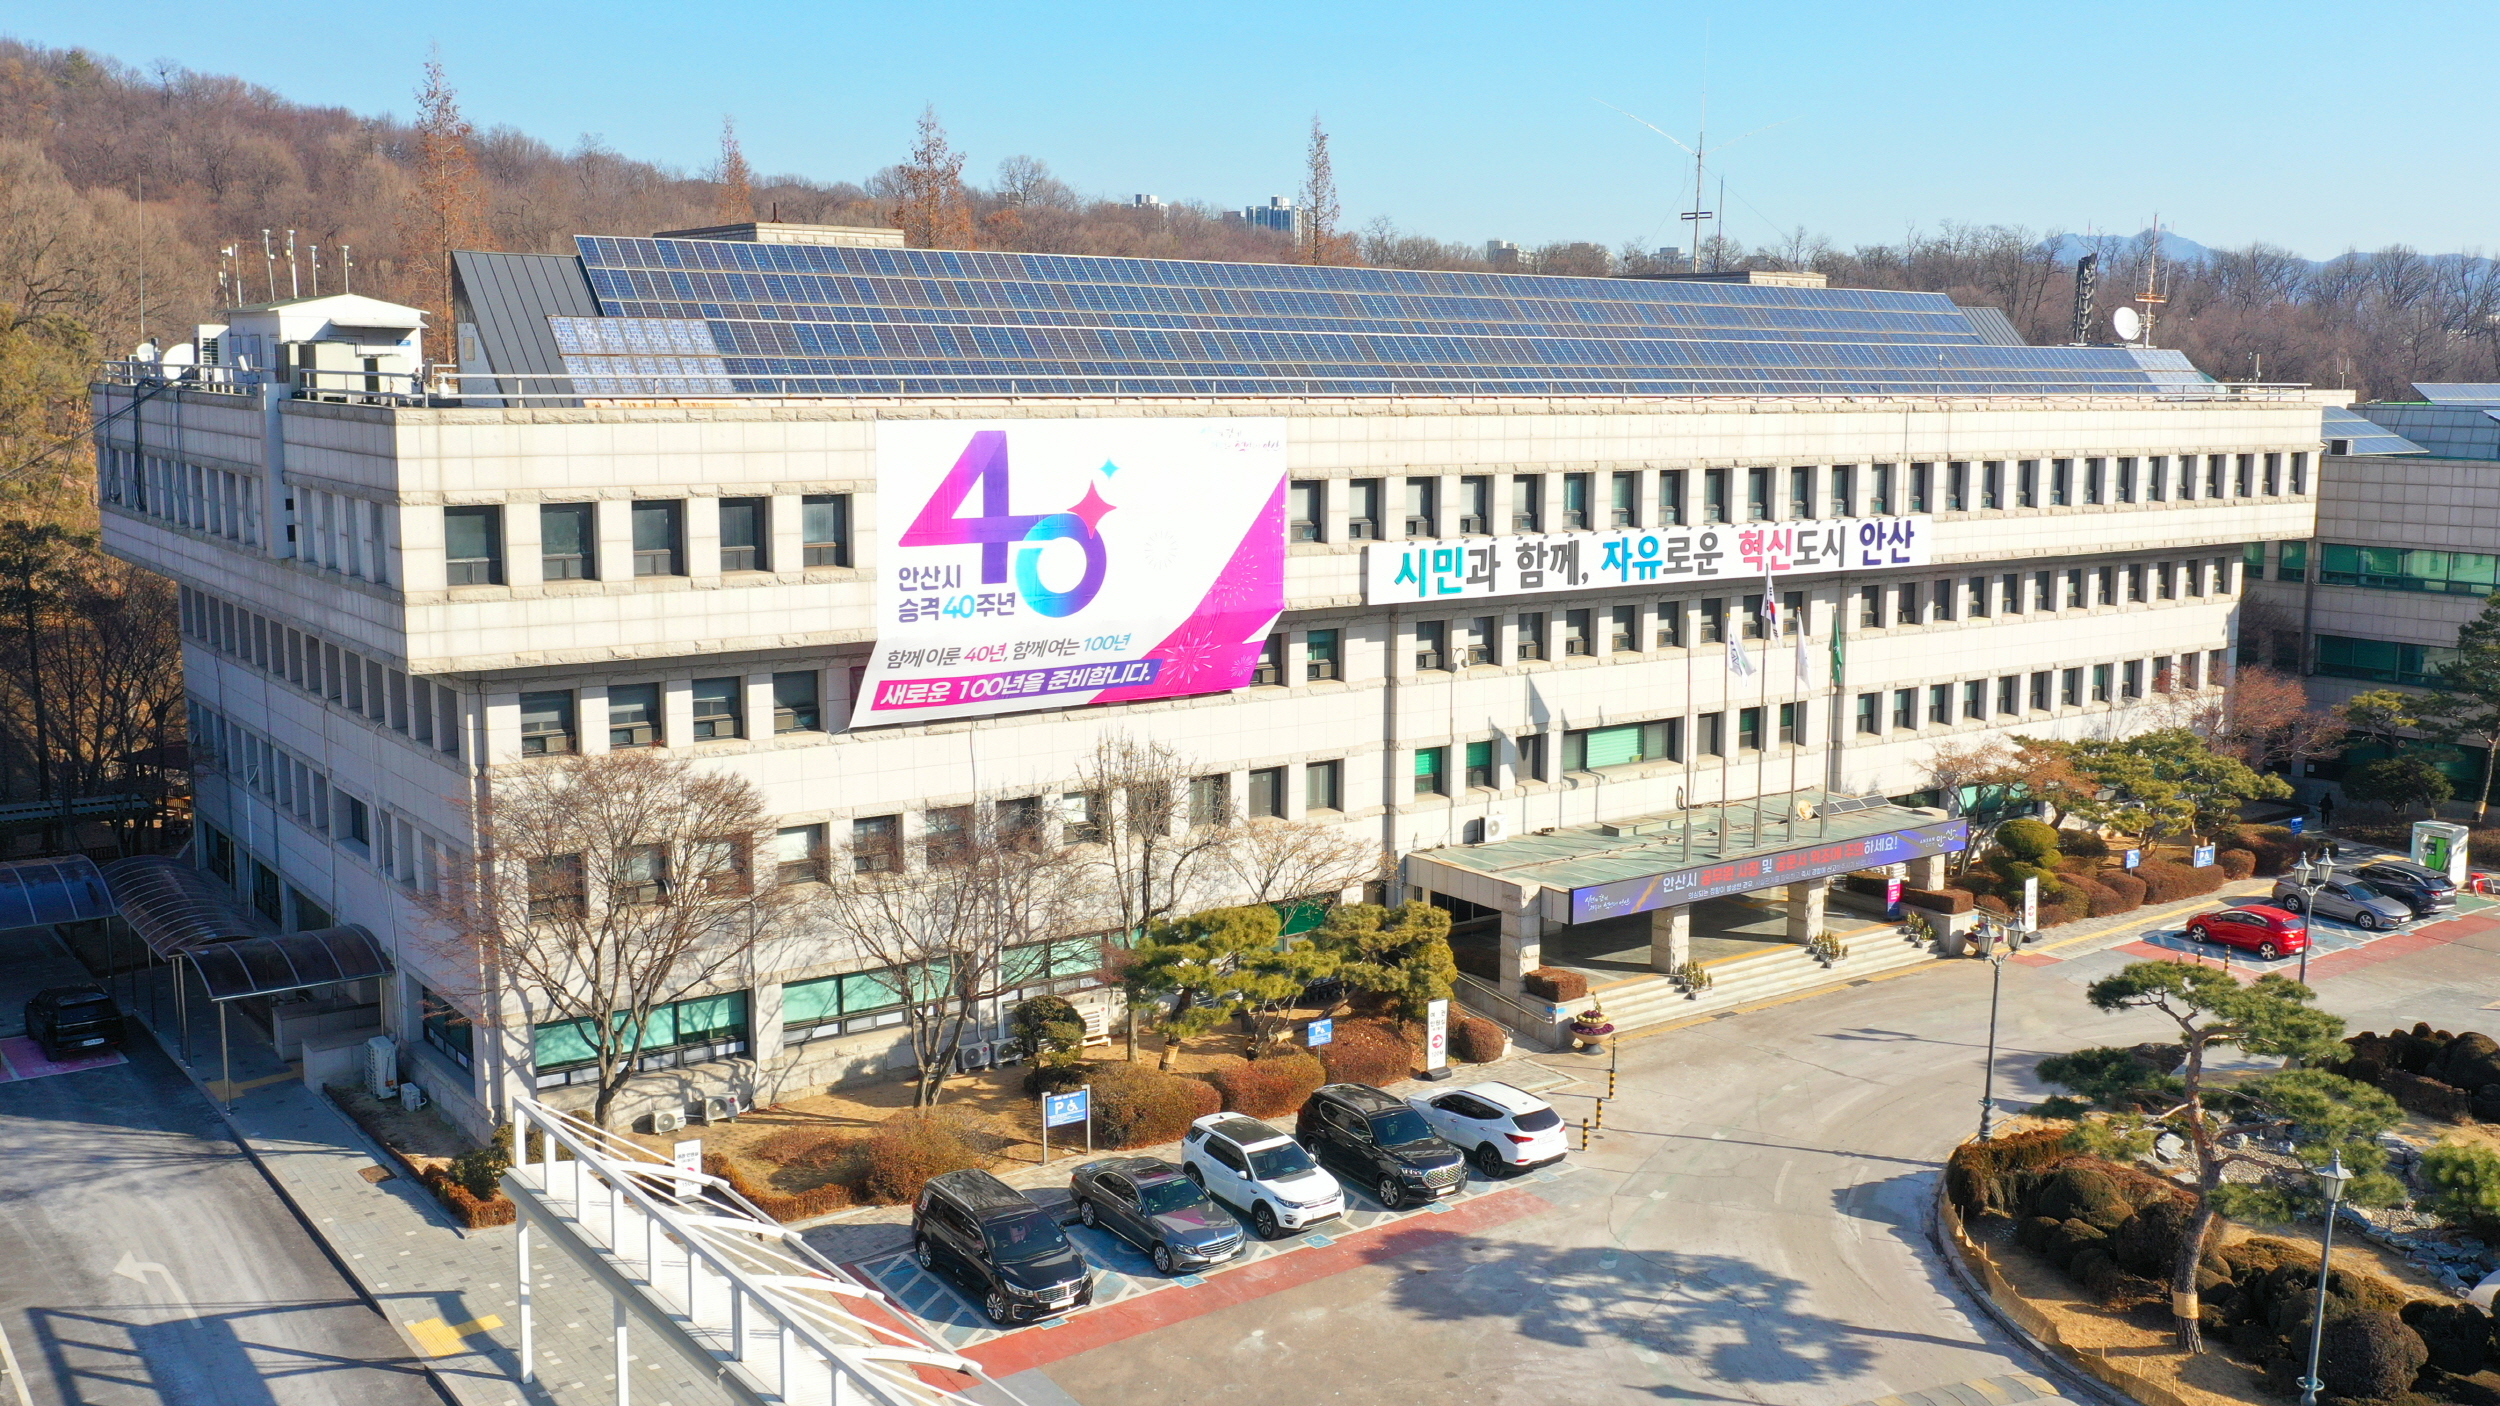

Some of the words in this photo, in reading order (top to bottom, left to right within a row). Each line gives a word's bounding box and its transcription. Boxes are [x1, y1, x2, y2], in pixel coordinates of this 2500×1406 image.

[1394, 544, 1501, 598] 시민과
[1515, 539, 1589, 589] 함께,
[1601, 532, 1724, 583] 자유로운
[1738, 526, 1846, 572] 혁신도시
[1859, 520, 1915, 566] 안산
[898, 564, 961, 592] 안산시
[964, 642, 1008, 663] 40년,
[1084, 633, 1132, 652] 100년
[880, 681, 952, 705] 새로운
[959, 672, 1046, 700] 100년을
[1047, 662, 1151, 691] 준비합니다.
[1663, 872, 1697, 893] 안산시
[1701, 865, 1735, 886] 공무원
[1762, 858, 1772, 874] 및
[1776, 853, 1808, 872] 공문서
[1054, 1101, 1065, 1115] P
